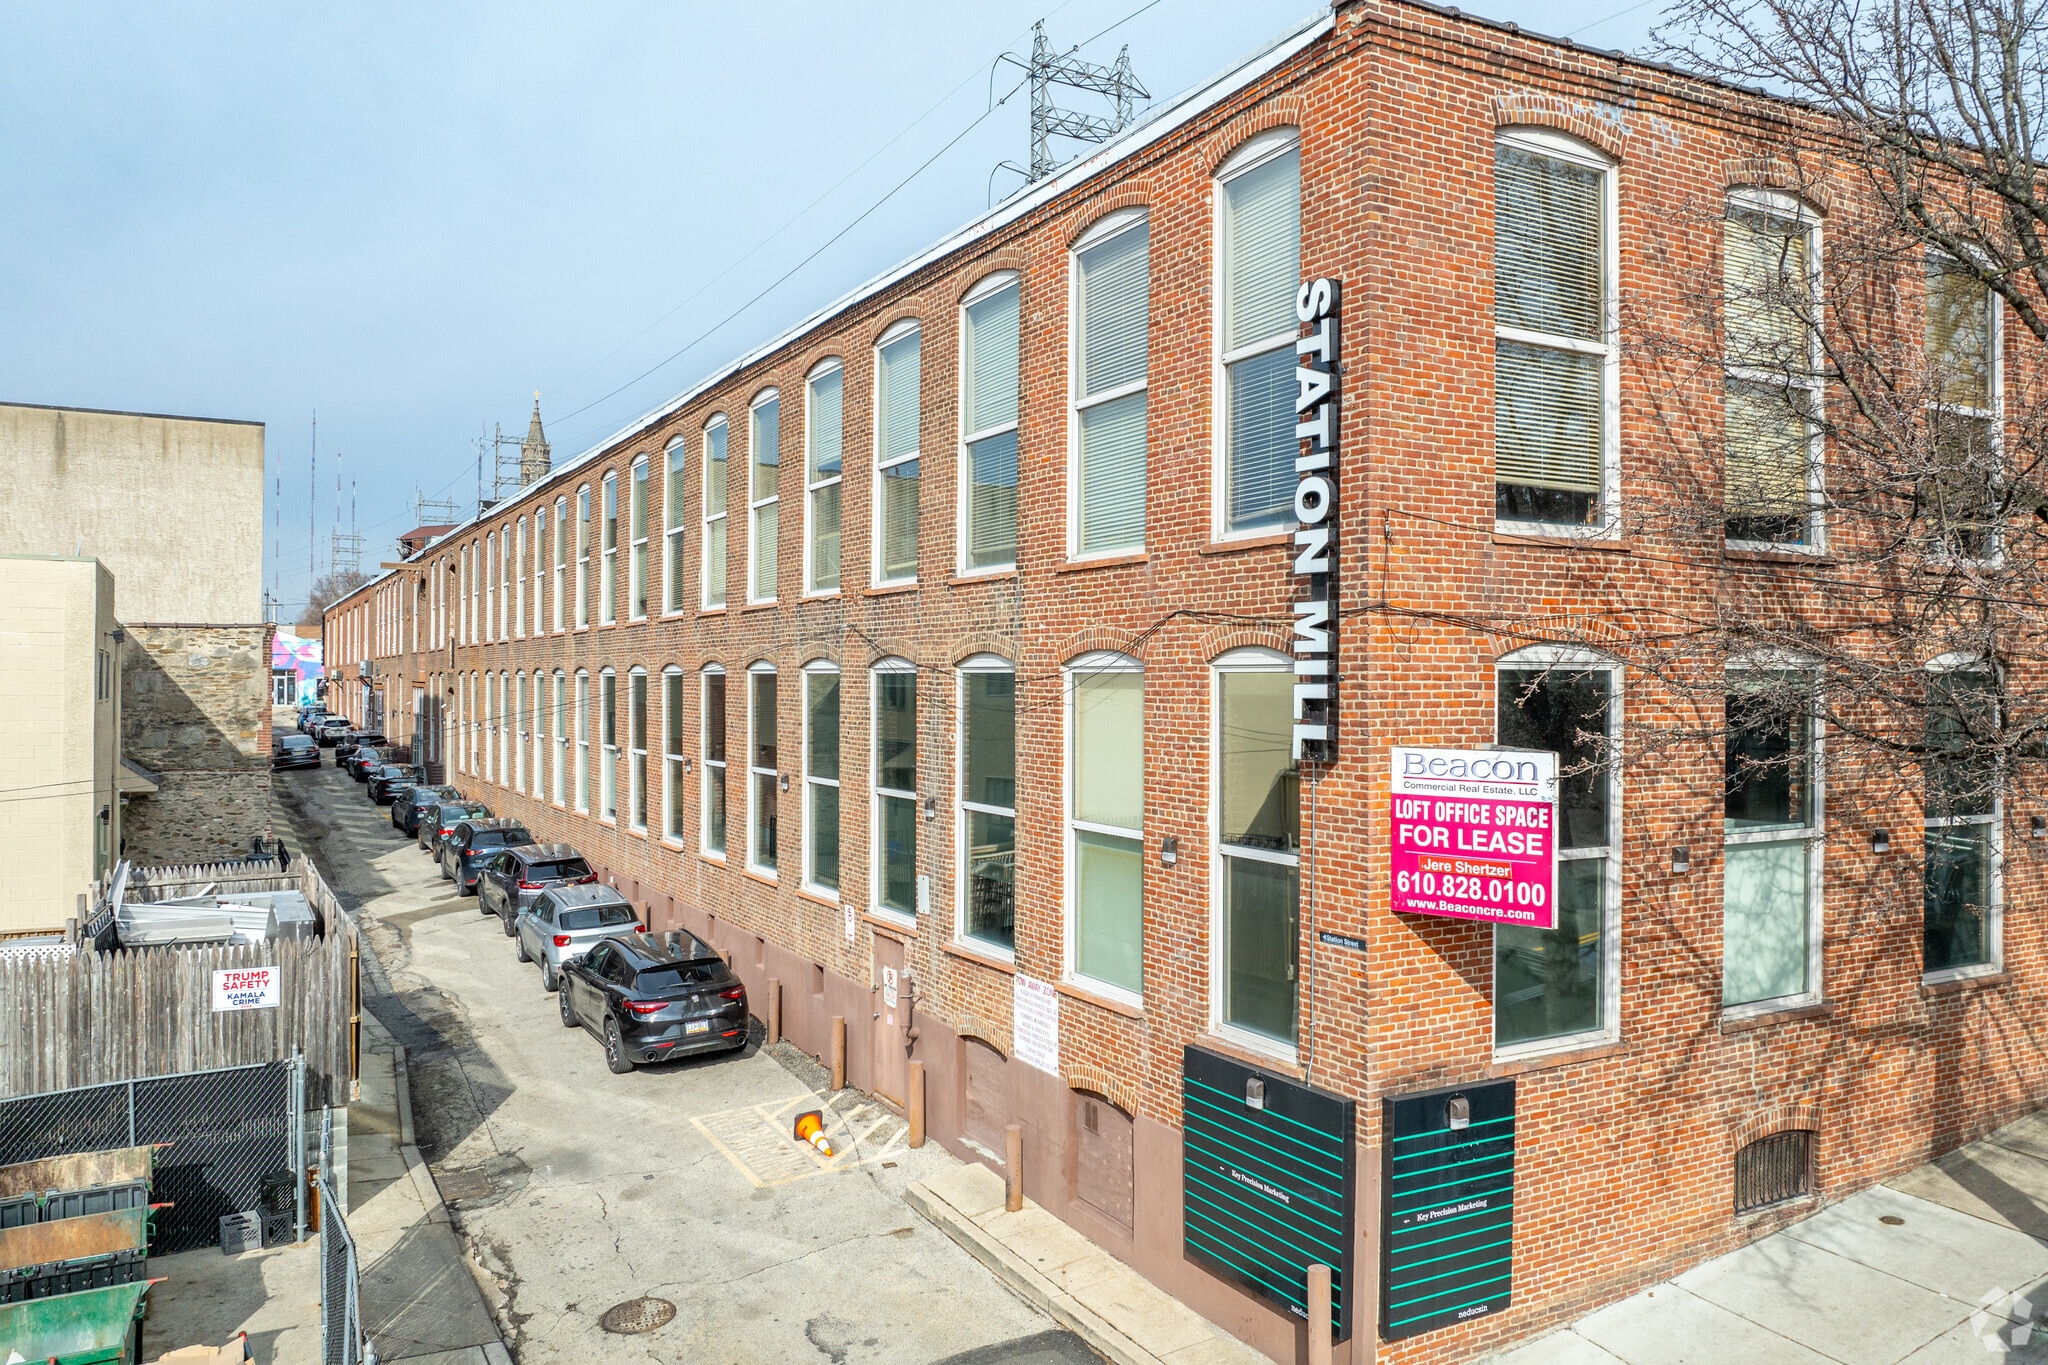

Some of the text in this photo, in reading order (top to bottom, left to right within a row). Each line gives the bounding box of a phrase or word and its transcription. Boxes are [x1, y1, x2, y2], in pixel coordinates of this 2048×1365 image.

[1293, 277, 1333, 760] STATION MILL
[1403, 753, 1539, 782] Beacon
[1403, 781, 1538, 796] Commercial Real Estate, LLC
[1395, 798, 1549, 829] LOFT OFFICE SPACE
[1399, 823, 1544, 856] FOR LEASE
[1422, 858, 1510, 877] Jere Shertzer
[1397, 870, 1546, 907] 610.828.0100
[1407, 898, 1535, 921] www.Beaconcre.com
[223, 979, 270, 990] SAFETY
[224, 971, 269, 981] TRUMP
[227, 991, 265, 1000] KAMALA
[1231, 1169, 1289, 1204] Key Precision Marketing
[1417, 1199, 1488, 1222] Key Precision Marketing
[1290, 1304, 1309, 1320] neduc
